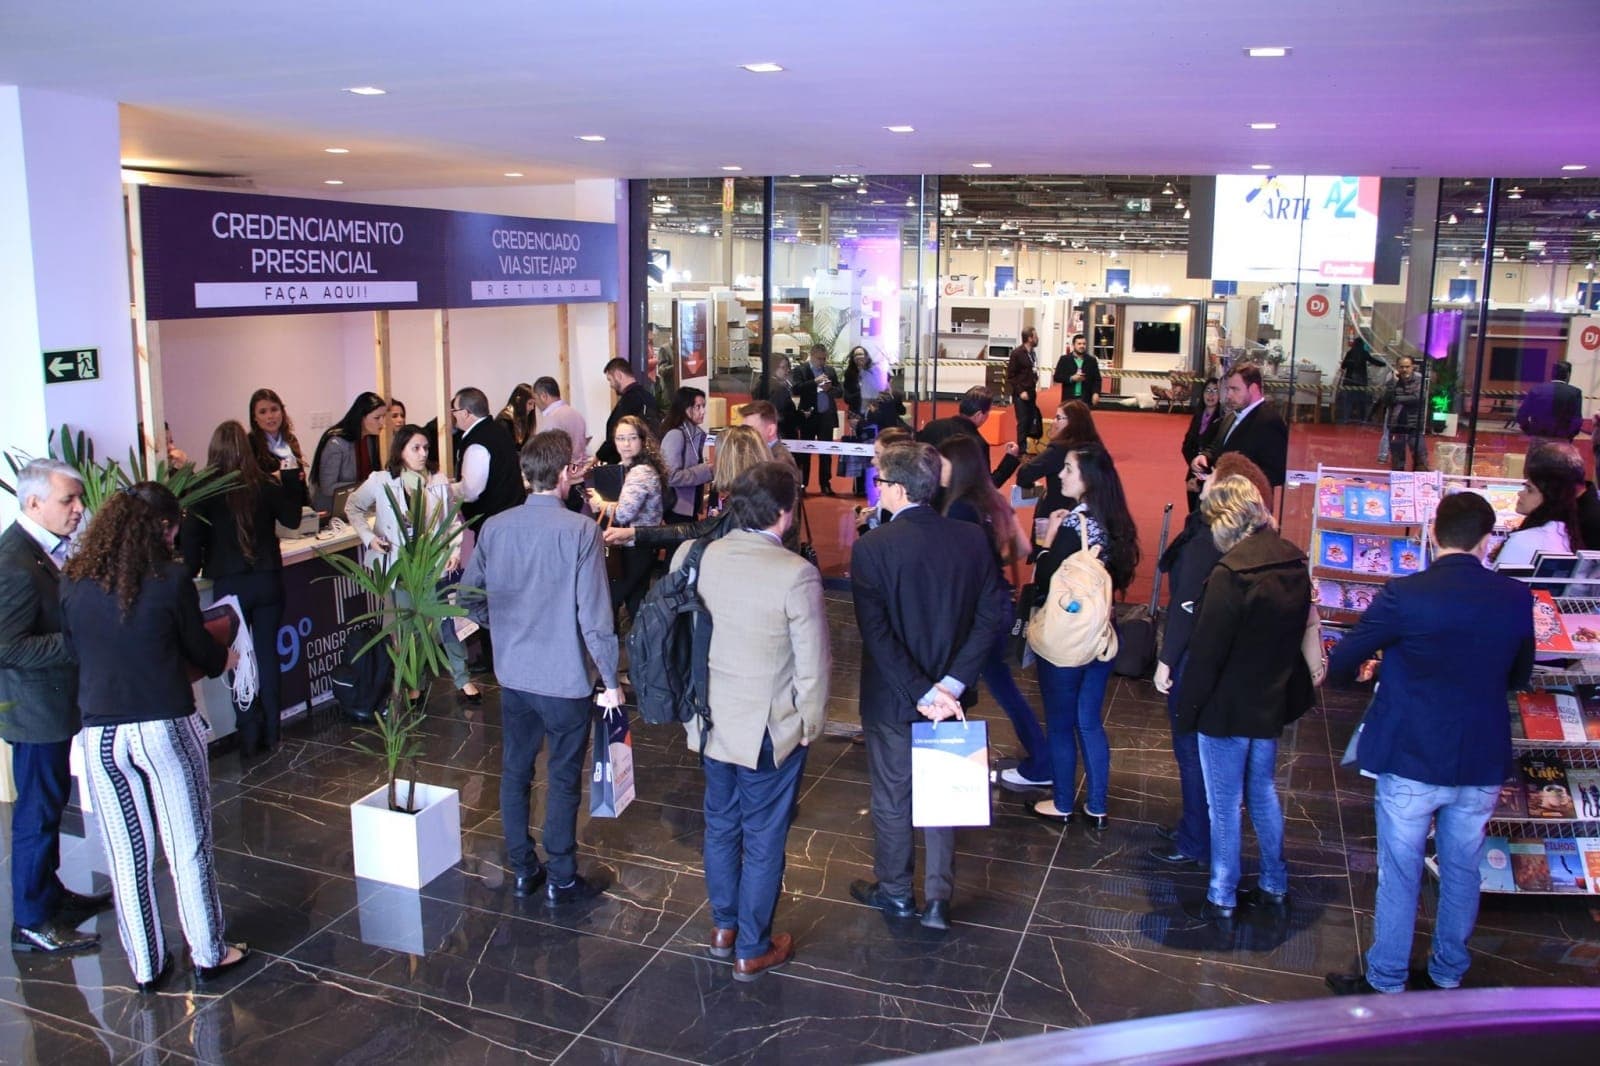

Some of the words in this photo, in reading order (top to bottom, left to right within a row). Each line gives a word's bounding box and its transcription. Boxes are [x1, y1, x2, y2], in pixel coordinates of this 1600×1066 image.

[212, 212, 404, 245] CREDENCIAMENTO
[492, 229, 581, 251] CREDENCIADO
[252, 249, 378, 274] PRESENCIAL
[499, 256, 522, 275] VIA
[523, 256, 577, 277] SITE/APP
[265, 286, 308, 304] FAÇA
[323, 286, 368, 299] AQUI!
[487, 283, 590, 296] RETIRADA
[1310, 301, 1325, 312] DJ
[1584, 332, 1599, 345] DJ
